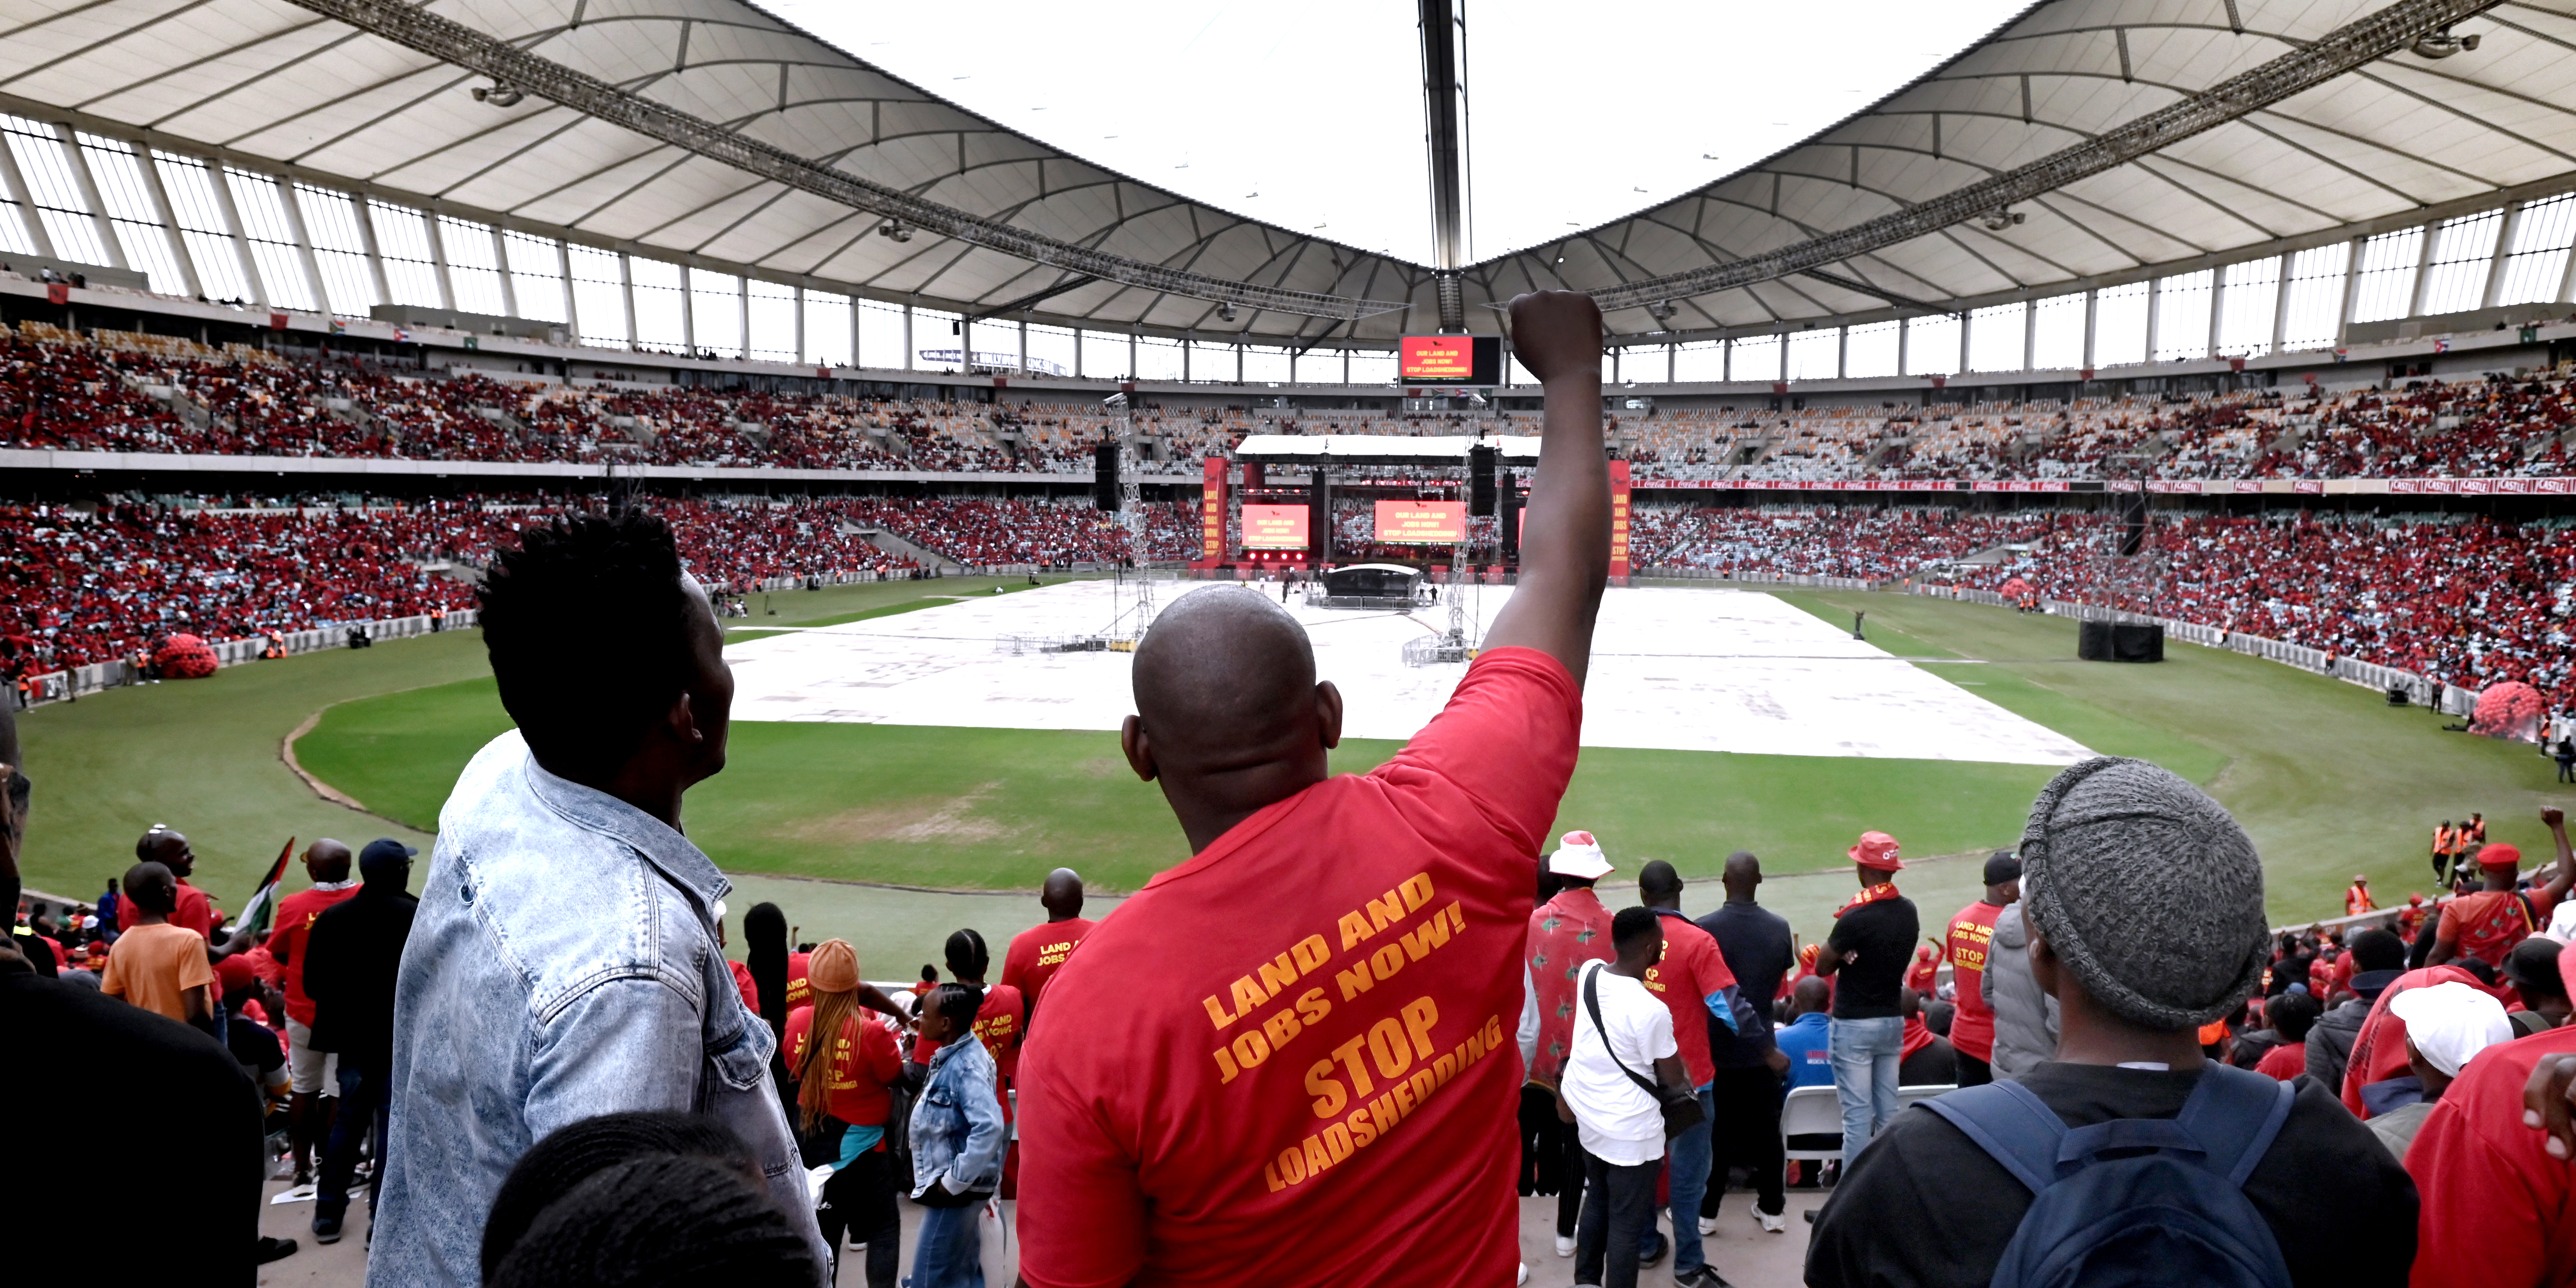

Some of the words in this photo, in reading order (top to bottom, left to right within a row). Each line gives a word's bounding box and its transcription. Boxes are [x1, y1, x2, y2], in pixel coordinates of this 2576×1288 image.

[2394, 481, 2415, 492] CASTLE
[2427, 481, 2451, 492] CASTLE
[2463, 481, 2487, 492] CASTLE
[2500, 480, 2525, 492] CASTLE
[2538, 480, 2565, 492] CASTLE
[1206, 541, 1219, 549] STOP
[1613, 546, 1626, 555] STOP
[1956, 921, 1975, 931] LAND
[1975, 924, 1994, 936] AND
[1040, 942, 1071, 955] LAND
[1203, 934, 1331, 1030] LAND
[1338, 872, 1434, 952] AND
[1037, 953, 1065, 966] JOBS
[1956, 947, 1984, 963] STOP
[1213, 987, 1331, 1084] JOBS
[1336, 900, 1466, 1002] NOW!
[992, 1014, 1012, 1026] AND
[1305, 996, 1439, 1119] STOP
[1265, 1014, 1503, 1193] LOADSHEDDING
